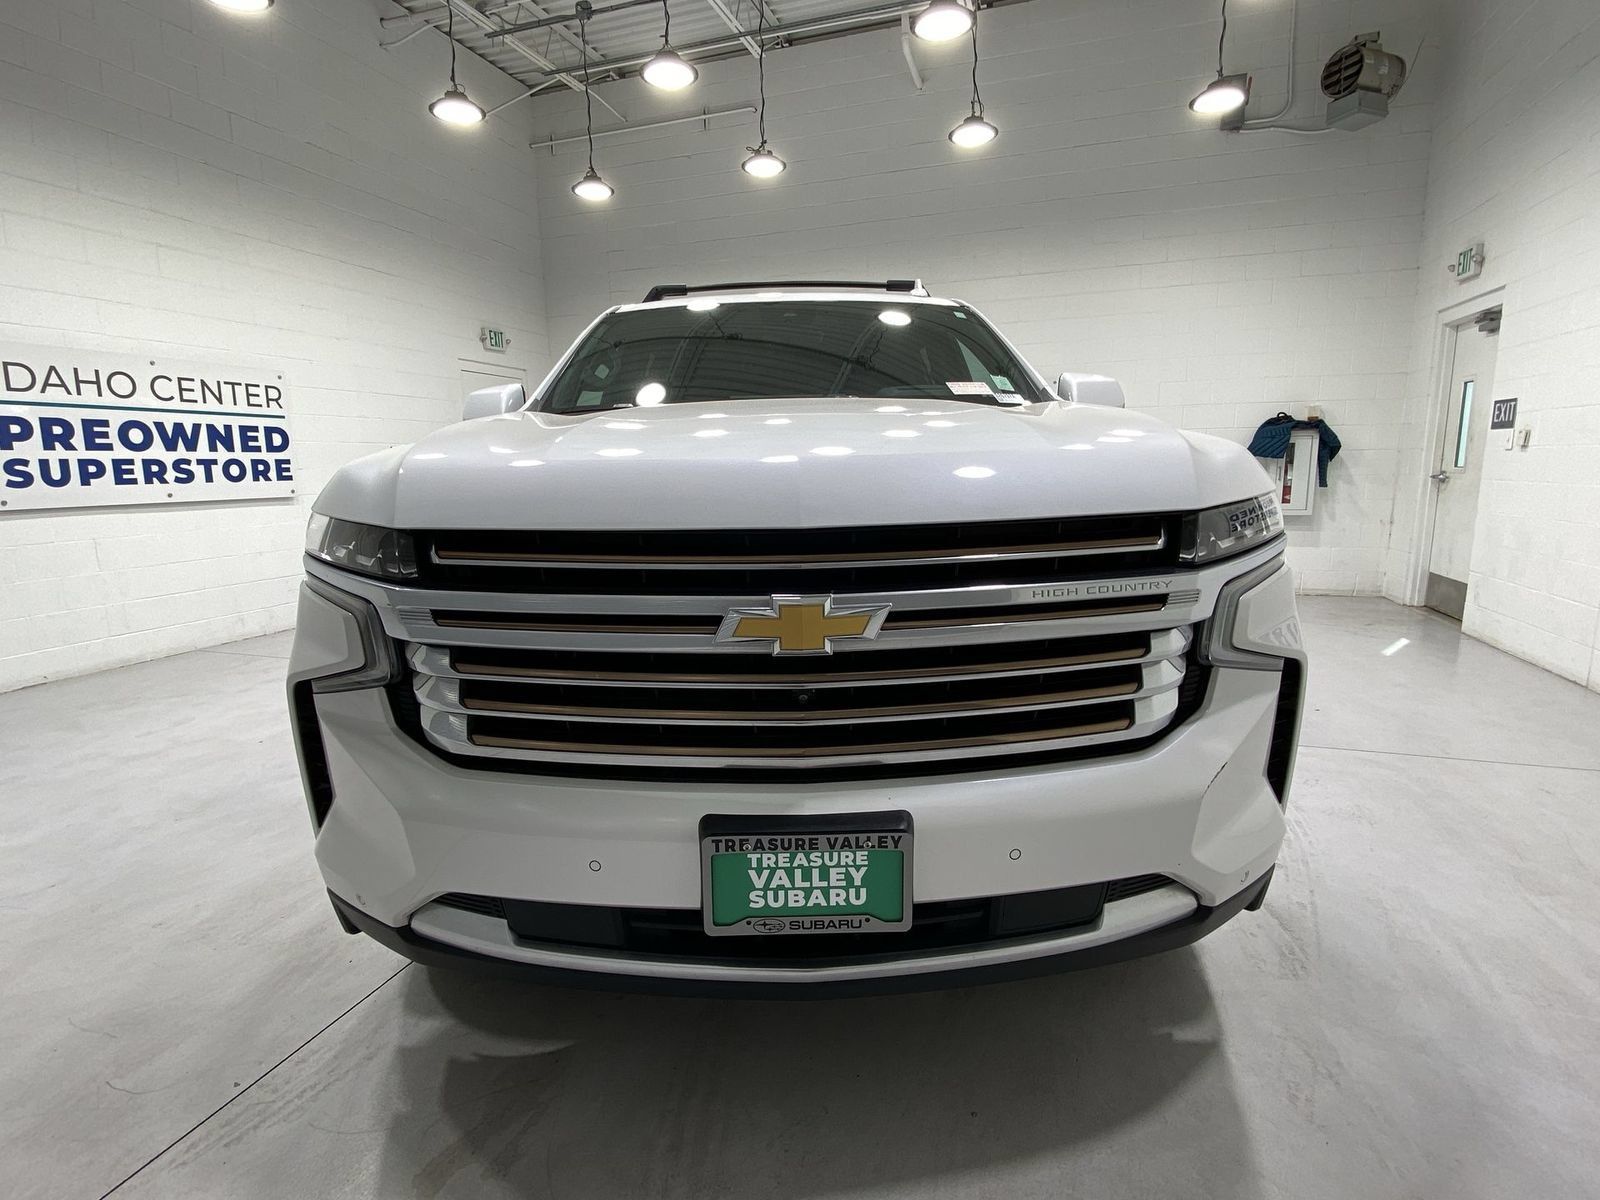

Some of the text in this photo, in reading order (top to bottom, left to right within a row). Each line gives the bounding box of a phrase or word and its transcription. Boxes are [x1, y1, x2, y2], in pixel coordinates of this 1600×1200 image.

[1457, 248, 1473, 276] EXIT
[489, 330, 503, 348] EXIT
[2, 361, 283, 409] DAHO CENTER
[1494, 401, 1516, 423] EXIT
[0, 415, 290, 453] PREOWNED
[2, 458, 293, 489] SUPERSTORE
[1032, 580, 1173, 598] HIGH COUNTRY
[712, 835, 903, 853] TREASURE VALLEY
[747, 851, 868, 868] TREASURE
[747, 867, 868, 888] VALLEY
[749, 887, 867, 908] SUBARU
[789, 919, 862, 930] SUBARU
